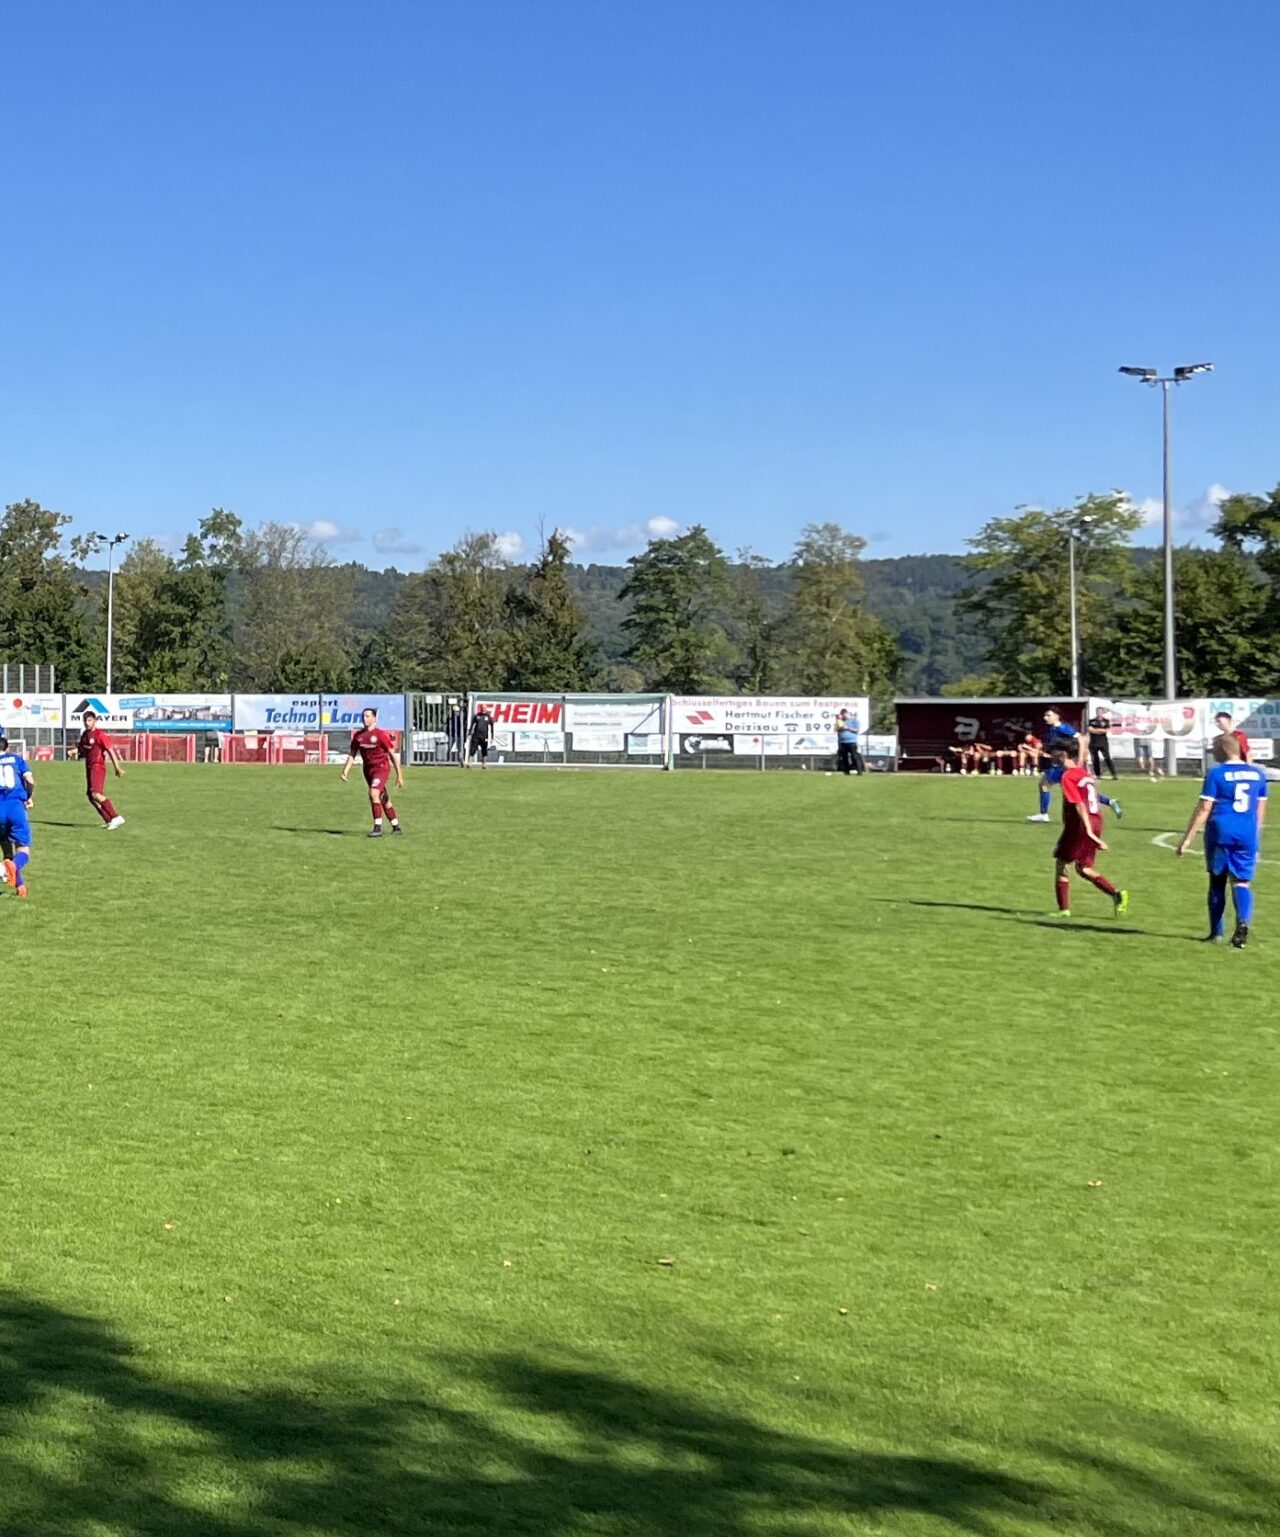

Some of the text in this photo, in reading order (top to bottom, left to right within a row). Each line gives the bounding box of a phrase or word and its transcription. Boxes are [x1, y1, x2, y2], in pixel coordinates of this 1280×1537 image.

[755, 699, 788, 708] Bauen
[265, 707, 370, 724] Techno Lan
[725, 710, 771, 719] Hartmut
[775, 710, 814, 719] Fischer
[725, 722, 779, 731] Deizisau
[1233, 782, 1250, 813] 5
